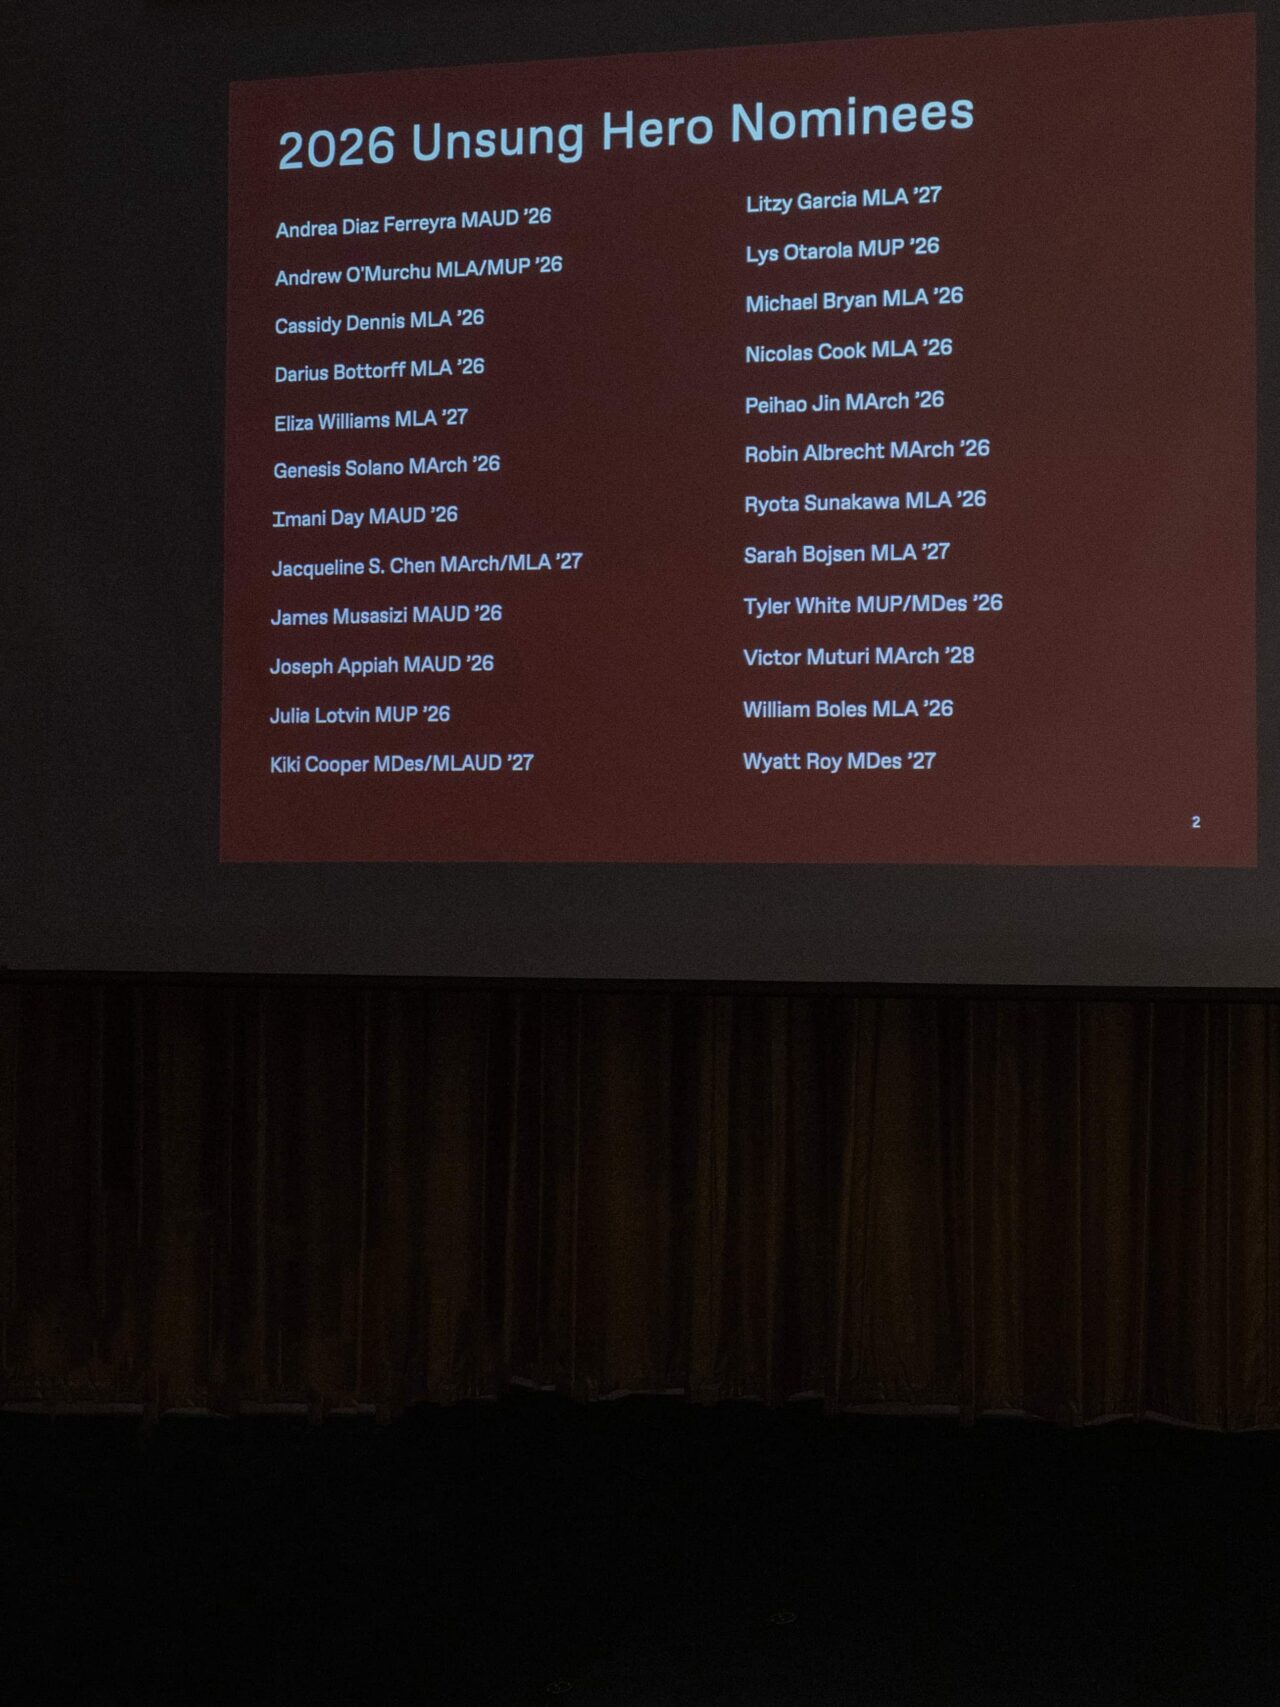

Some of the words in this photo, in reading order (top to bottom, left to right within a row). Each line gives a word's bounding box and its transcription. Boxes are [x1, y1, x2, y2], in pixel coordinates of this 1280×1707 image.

[279, 125, 396, 170] 2026
[413, 122, 583, 164] Unsung
[603, 110, 714, 151] Hero
[731, 96, 974, 143] Nominees
[746, 195, 794, 216] Litzy
[796, 190, 858, 211] Garcia
[862, 187, 910, 207] MLA
[912, 185, 943, 204] ’27
[275, 220, 338, 239] Andrea
[342, 217, 380, 235] Diaz
[383, 215, 457, 235] Ferreyra
[461, 208, 520, 229] MAUD
[523, 206, 552, 225] ’26
[746, 245, 780, 267] Lys
[783, 241, 853, 261] Otarola
[858, 238, 905, 258] MUP
[909, 236, 940, 255] ’26
[274, 268, 343, 287] Andrew
[345, 263, 432, 283] O'Murchu
[436, 257, 531, 279] MLA/MUP
[534, 255, 563, 273] ’26
[745, 292, 818, 313] Michael
[822, 291, 878, 313] Bryan
[882, 287, 930, 307] MLA
[933, 285, 964, 305] ’26
[274, 315, 343, 336] Cassidy
[346, 312, 406, 332] Dennis
[410, 309, 453, 329] MLA
[456, 308, 485, 326] ’26
[745, 344, 814, 363] Nicolas
[817, 341, 867, 361] Cook
[871, 339, 919, 358] MLA
[922, 337, 953, 357] ’26
[275, 364, 329, 383] Darius
[333, 360, 407, 381] Bottorff
[410, 358, 453, 377] MLA
[456, 357, 485, 375] ’26
[745, 395, 808, 415] Peihao
[811, 394, 841, 412] Jin
[845, 391, 910, 411] MArch
[914, 389, 945, 409] ’26
[274, 414, 314, 433] Eliza
[317, 412, 391, 430] Williams
[395, 409, 438, 428] MLA
[441, 407, 469, 426] ’27
[745, 444, 799, 464] Robin
[802, 442, 886, 462] Albrecht
[889, 439, 955, 459] MArch
[959, 438, 991, 457] ’26
[273, 460, 342, 479] Genesis
[345, 459, 405, 477] Solano
[408, 455, 468, 475] MArch
[472, 454, 501, 472] ’26
[744, 495, 800, 517] Ryota
[803, 492, 900, 512] Sunakawa
[905, 490, 953, 509] MLA
[956, 489, 987, 508] ’26
[272, 509, 327, 528] Imani
[331, 508, 365, 529] Day
[369, 506, 427, 525] MAUD
[430, 505, 459, 523] ’26
[271, 558, 365, 581] Jacqueline
[368, 557, 385, 575] S.
[389, 556, 436, 574] Chen
[440, 552, 552, 573] MArch/MLA
[555, 551, 584, 570] ’27
[743, 545, 798, 564] Sarah
[802, 544, 866, 567] Bojsen
[870, 543, 918, 562] MLA
[921, 541, 951, 561] ’27
[270, 608, 329, 626] James
[333, 606, 408, 625] Musasizi
[412, 604, 471, 623] MAUD
[474, 603, 503, 622] ’26
[743, 597, 792, 619] Tyler
[794, 596, 852, 614] White
[856, 593, 968, 614] MUP/MDes
[972, 593, 1003, 612] ’26
[269, 657, 334, 679] Joseph
[337, 656, 399, 678] Appiah
[403, 655, 462, 673] MAUD
[466, 654, 495, 672] ’26
[743, 648, 802, 666] Victor
[806, 646, 870, 666] Muturi
[874, 646, 940, 665] MArch
[944, 645, 975, 665] ’28
[269, 707, 311, 725] Julia
[315, 706, 371, 724] Lotvin
[375, 705, 419, 723] MUP
[422, 704, 451, 723] ’26
[743, 700, 811, 719] William
[815, 699, 868, 718] Boles
[872, 699, 920, 718] MLA
[923, 698, 954, 717] ’26
[270, 755, 301, 774] Kiki
[304, 755, 370, 777] Cooper
[373, 753, 503, 773] MDes/MLAUD
[507, 753, 535, 771] ’27
[742, 752, 802, 774] Wyatt
[806, 751, 843, 774] Roy
[847, 751, 903, 770] MDes
[907, 751, 937, 770] ’27
[1191, 815, 1201, 829] 2
